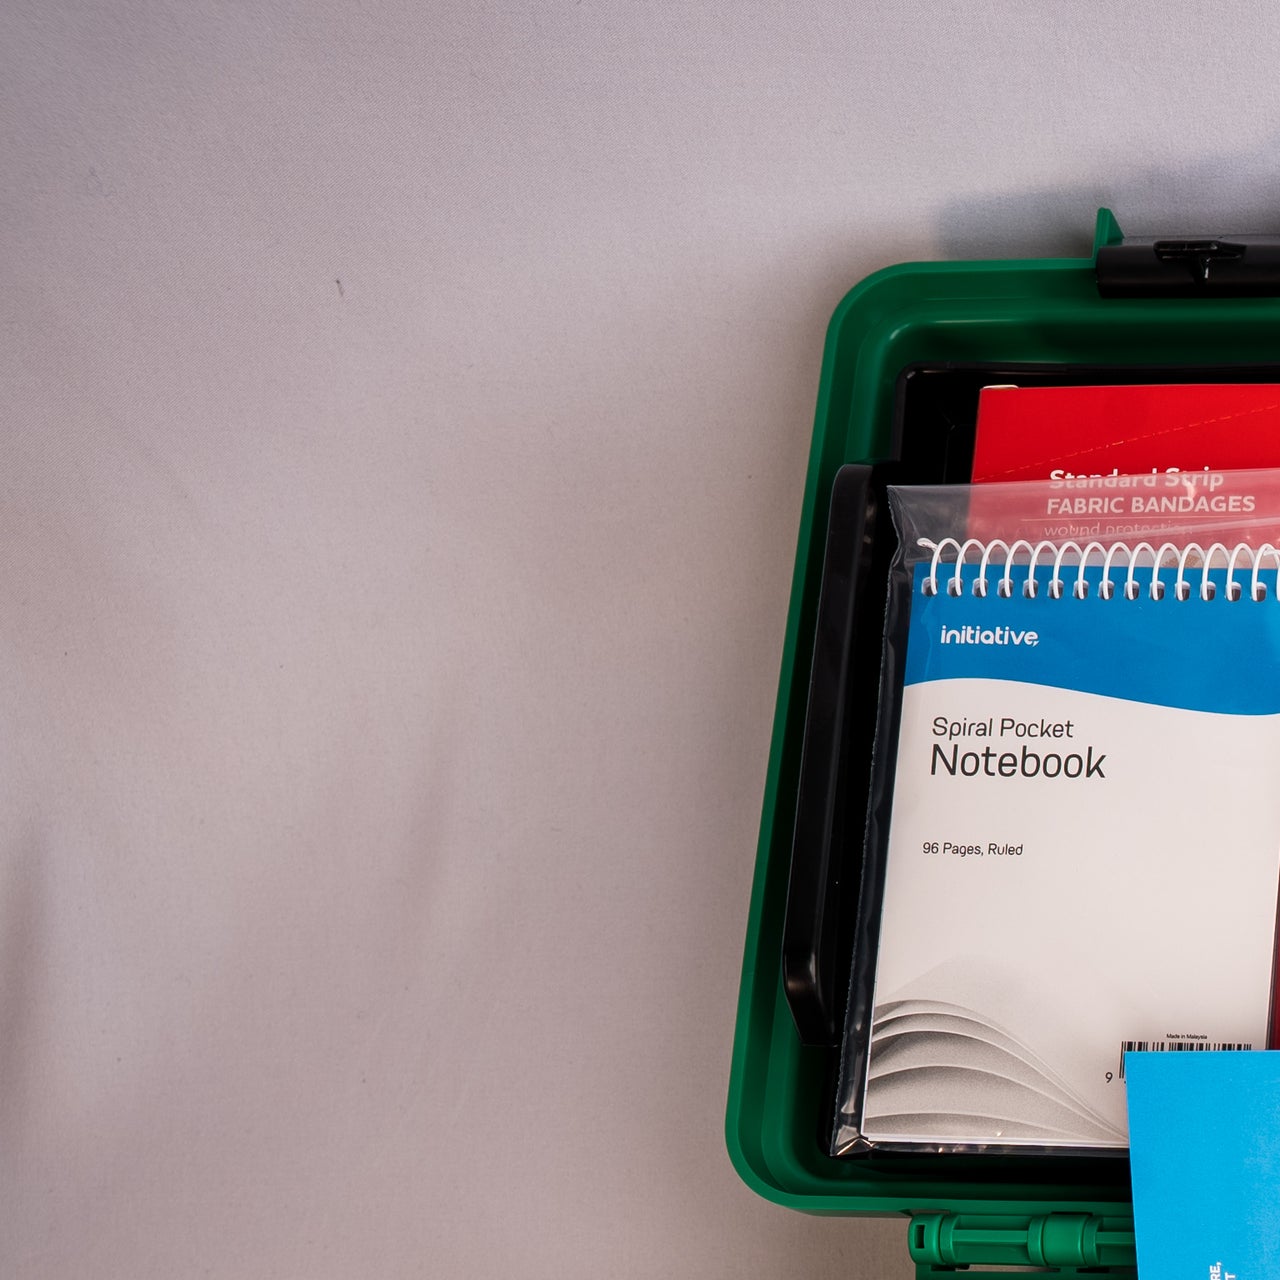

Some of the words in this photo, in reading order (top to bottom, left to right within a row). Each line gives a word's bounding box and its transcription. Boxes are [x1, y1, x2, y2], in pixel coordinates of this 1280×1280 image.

[1050, 468, 1157, 489] Standard
[1165, 466, 1224, 492] Strip
[1047, 497, 1124, 514] FABRIC
[1131, 495, 1257, 513] BANDAGES
[932, 717, 992, 740] Spiral
[1000, 718, 1073, 738] Pocket
[930, 739, 1105, 778] Notebook
[922, 841, 938, 853] 96
[943, 842, 983, 857] Pages,
[988, 843, 1023, 855] Ruled
